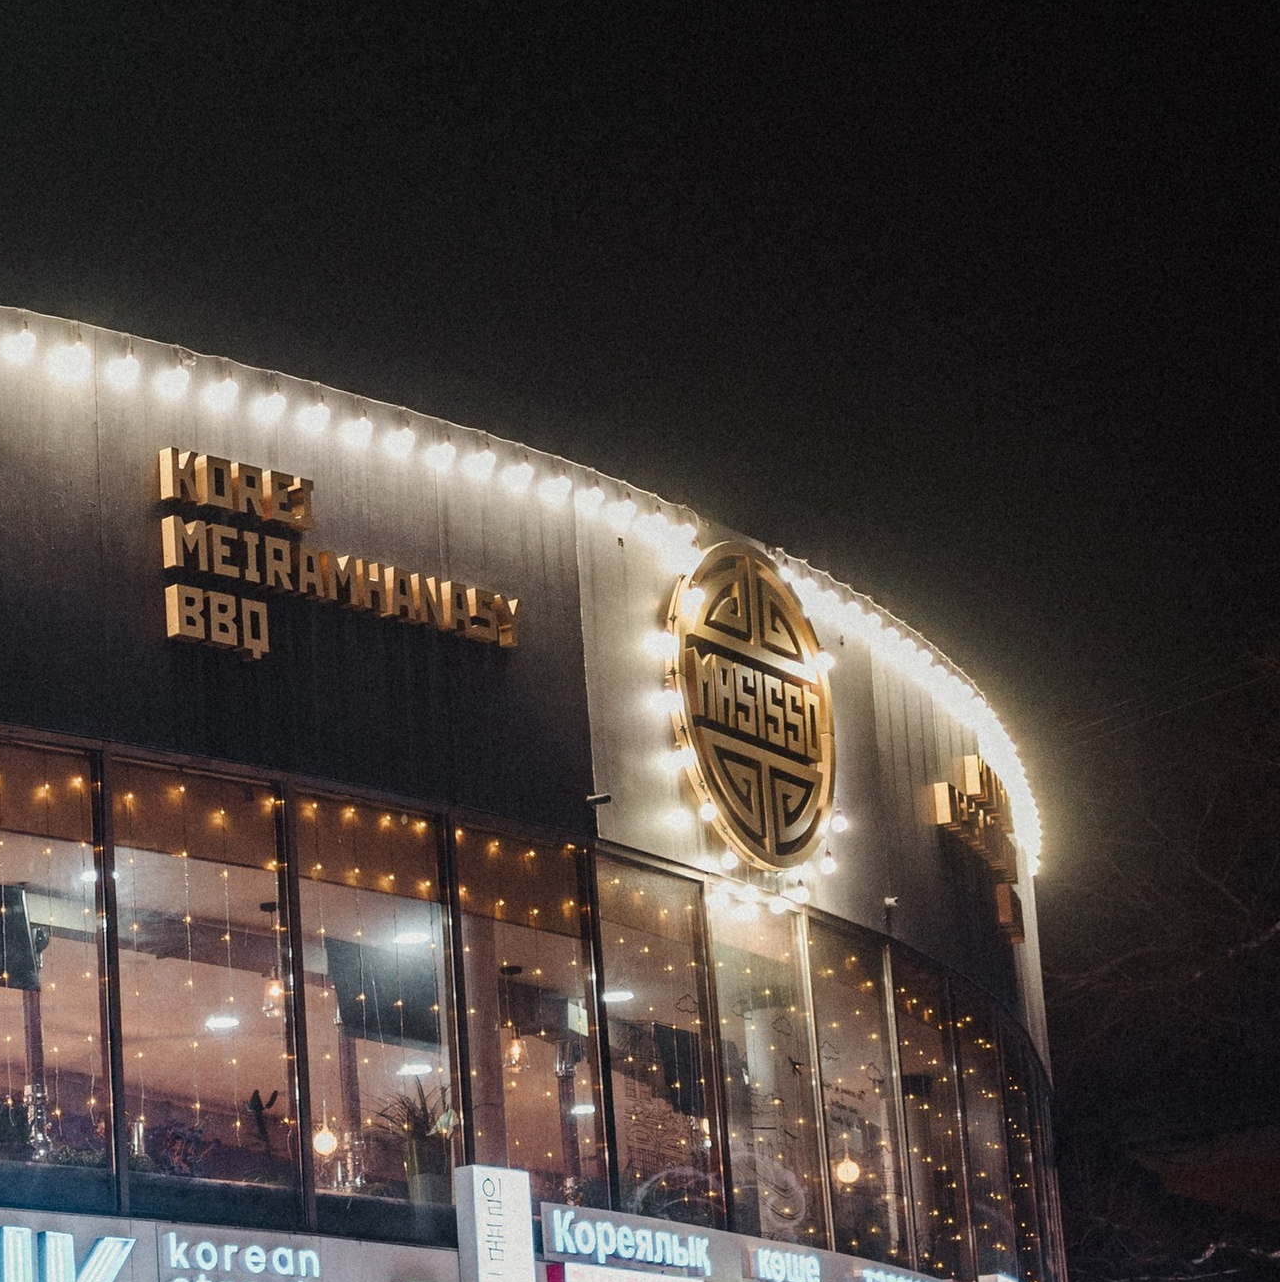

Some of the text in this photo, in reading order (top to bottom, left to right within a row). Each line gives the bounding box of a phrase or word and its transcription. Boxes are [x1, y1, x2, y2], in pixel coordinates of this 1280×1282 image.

[161, 514, 519, 648] MEIRAMHANASY
[165, 583, 271, 661] BBQ
[686, 647, 822, 762] MASISSO
[167, 1231, 320, 1279] korean
[552, 1208, 712, 1278] Кореялық
